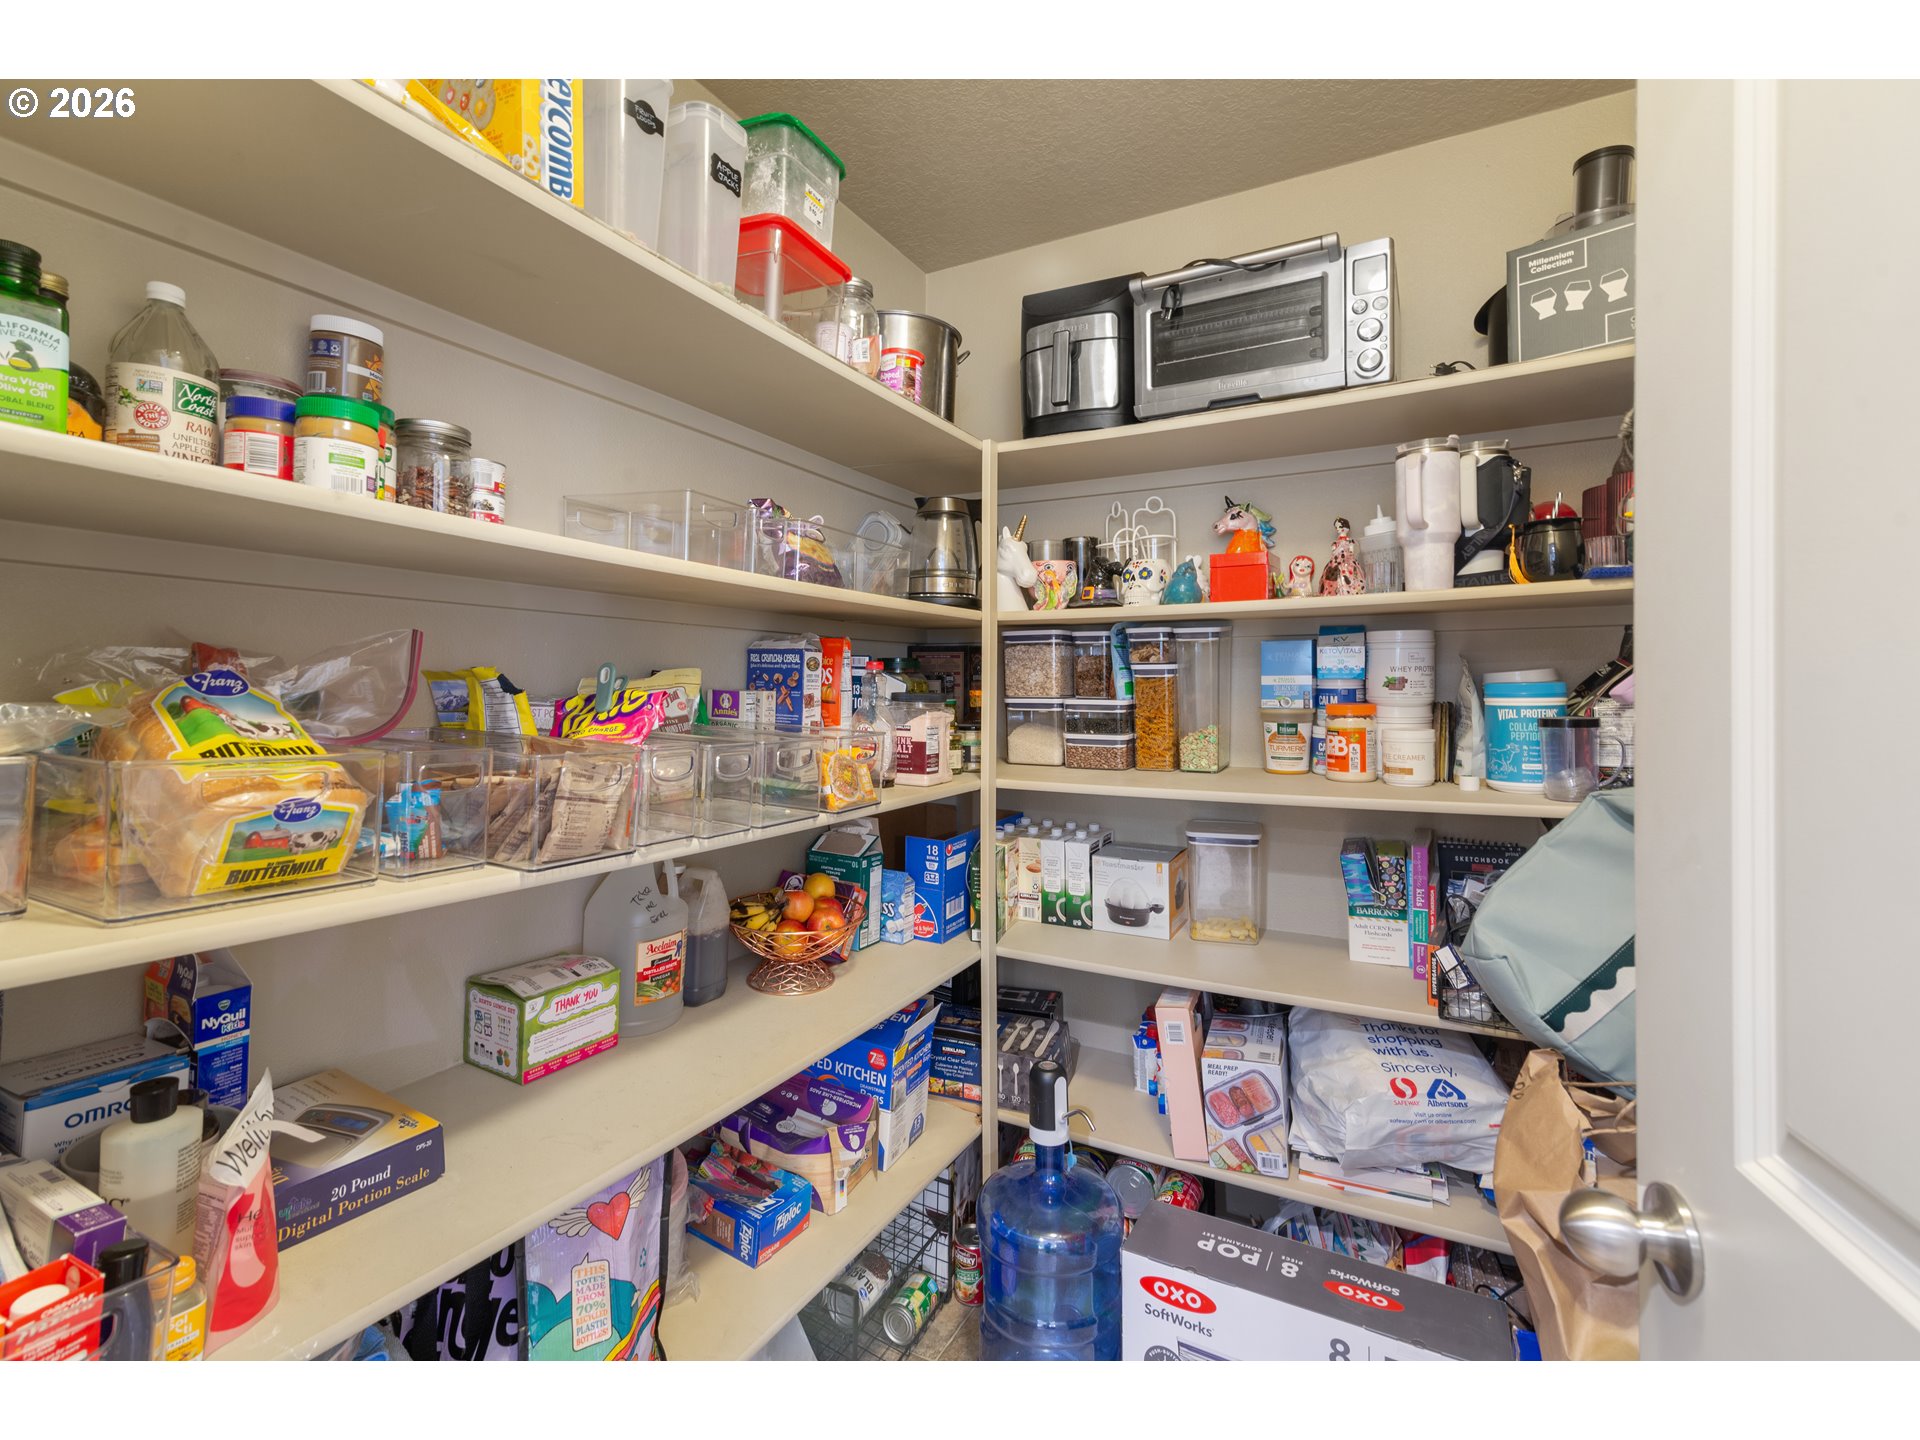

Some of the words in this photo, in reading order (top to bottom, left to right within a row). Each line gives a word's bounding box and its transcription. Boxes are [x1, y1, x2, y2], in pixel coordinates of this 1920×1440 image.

[717, 161, 739, 182] APPLE
[718, 172, 739, 193] JACKS
[1528, 250, 1575, 268] Millennium
[1530, 257, 1573, 274] Collection
[19, 329, 58, 351] RANCH
[20, 377, 55, 391] Virgin
[29, 386, 48, 399] Oil
[178, 383, 217, 408] North
[26, 399, 54, 411] BLEND
[138, 403, 161, 413] WITH
[177, 397, 216, 418] Coast
[137, 415, 168, 429] MOTHER
[144, 412, 160, 420] THE
[186, 421, 214, 437] RAW
[172, 441, 200, 454] APPLE
[1390, 665, 1412, 673] WHEY
[191, 671, 244, 696] Franz
[1319, 695, 1338, 705] CALM
[713, 707, 738, 717] Annie's
[1498, 708, 1518, 720] VITAL
[588, 725, 619, 733] CHARGE
[711, 720, 738, 728] ORGANIC
[1510, 732, 1540, 741] PEPTID
[1393, 753, 1426, 761] CREAMER
[279, 801, 317, 820] Franz
[926, 845, 938, 856] 18
[1102, 861, 1145, 871] Toastmaster
[1454, 855, 1510, 865] SKETCHBOOK
[225, 856, 329, 886] BUTTERMILK
[1416, 888, 1425, 908] kids
[1356, 907, 1400, 917] BARRON'S
[646, 939, 677, 955] Acclaim
[652, 972, 671, 982] VINEGAR
[555, 993, 581, 1013] THANK
[583, 988, 599, 1002] YOU
[201, 1008, 247, 1030] NyQuil
[221, 1020, 246, 1034] Kids
[1361, 1021, 1416, 1035] Thanks
[1420, 1026, 1440, 1036] for
[1368, 1034, 1443, 1049] shopping
[869, 1051, 877, 1063] 7
[942, 1046, 966, 1054] KIRKLAND
[1373, 1046, 1407, 1056] with
[1411, 1048, 1434, 1058] us.
[42, 1052, 144, 1082] OMRON
[961, 1059, 978, 1067] Cutlery
[1207, 1063, 1222, 1071] MEAL
[1381, 1062, 1458, 1077] Sincerely,
[835, 1061, 887, 1088] KITCHEN
[1207, 1069, 1228, 1077] READY!
[860, 1083, 886, 1095] DRAWSTRING
[1427, 1100, 1468, 1108] Albertsons
[54, 1139, 73, 1149] Why
[331, 1185, 346, 1202] 20
[351, 1165, 391, 1192] Pound
[277, 1211, 333, 1243] Digital
[338, 1185, 391, 1216] Portion
[396, 1167, 430, 1190] Scale
[776, 1202, 802, 1230] Ziploc
[739, 1223, 753, 1261] Ziploc
[1217, 1235, 1263, 1253] CONTAINER
[1197, 1238, 1261, 1267] POP
[1281, 1255, 1304, 1265] PIECE
[574, 1264, 606, 1279] THIS
[1281, 1262, 1299, 1278] 8
[575, 1274, 606, 1287] TOTE'S
[1327, 1268, 1400, 1296] SoftWorks
[575, 1282, 606, 1296] MADE
[1153, 1281, 1202, 1309] OXO
[1338, 1284, 1389, 1307] OXO
[576, 1291, 606, 1304] FROM
[576, 1300, 606, 1316] 70%
[576, 1308, 608, 1325] RECYCLED
[1144, 1303, 1214, 1338] SoftWorks
[576, 1317, 608, 1336] PLASTIC
[576, 1328, 609, 1347] BOTTLES!
